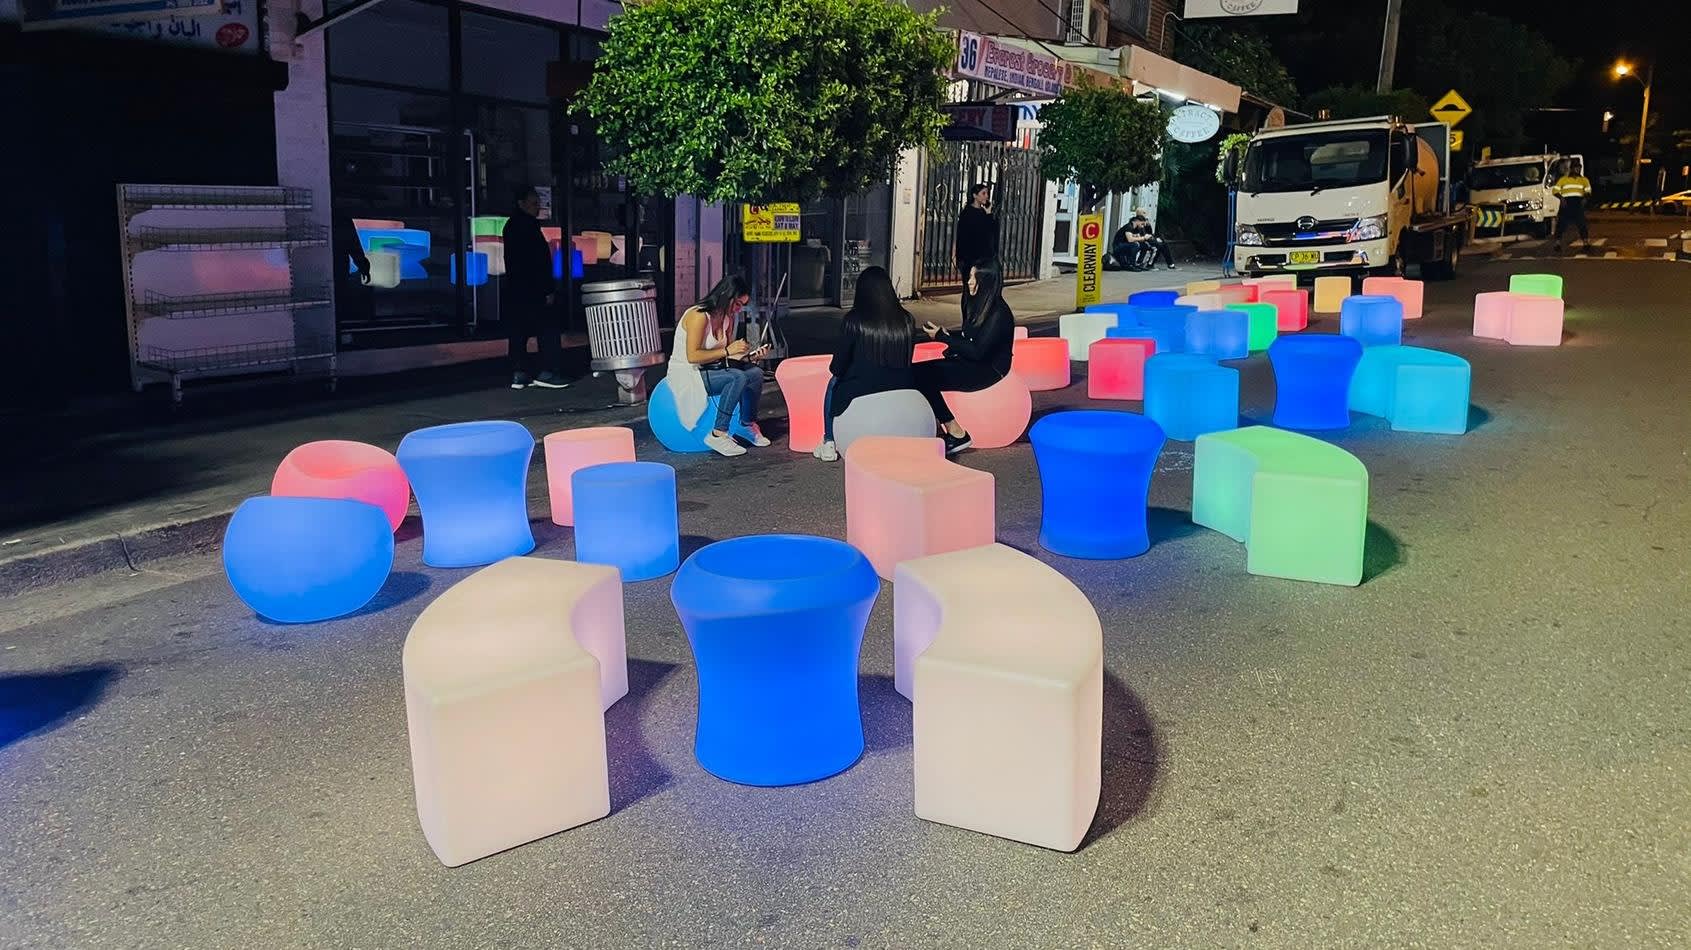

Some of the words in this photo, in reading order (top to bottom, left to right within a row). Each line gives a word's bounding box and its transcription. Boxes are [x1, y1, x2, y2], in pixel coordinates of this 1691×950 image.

[960, 36, 978, 71] 36
[986, 41, 1025, 72] Everest
[1083, 243, 1097, 292] CLEARWAY
